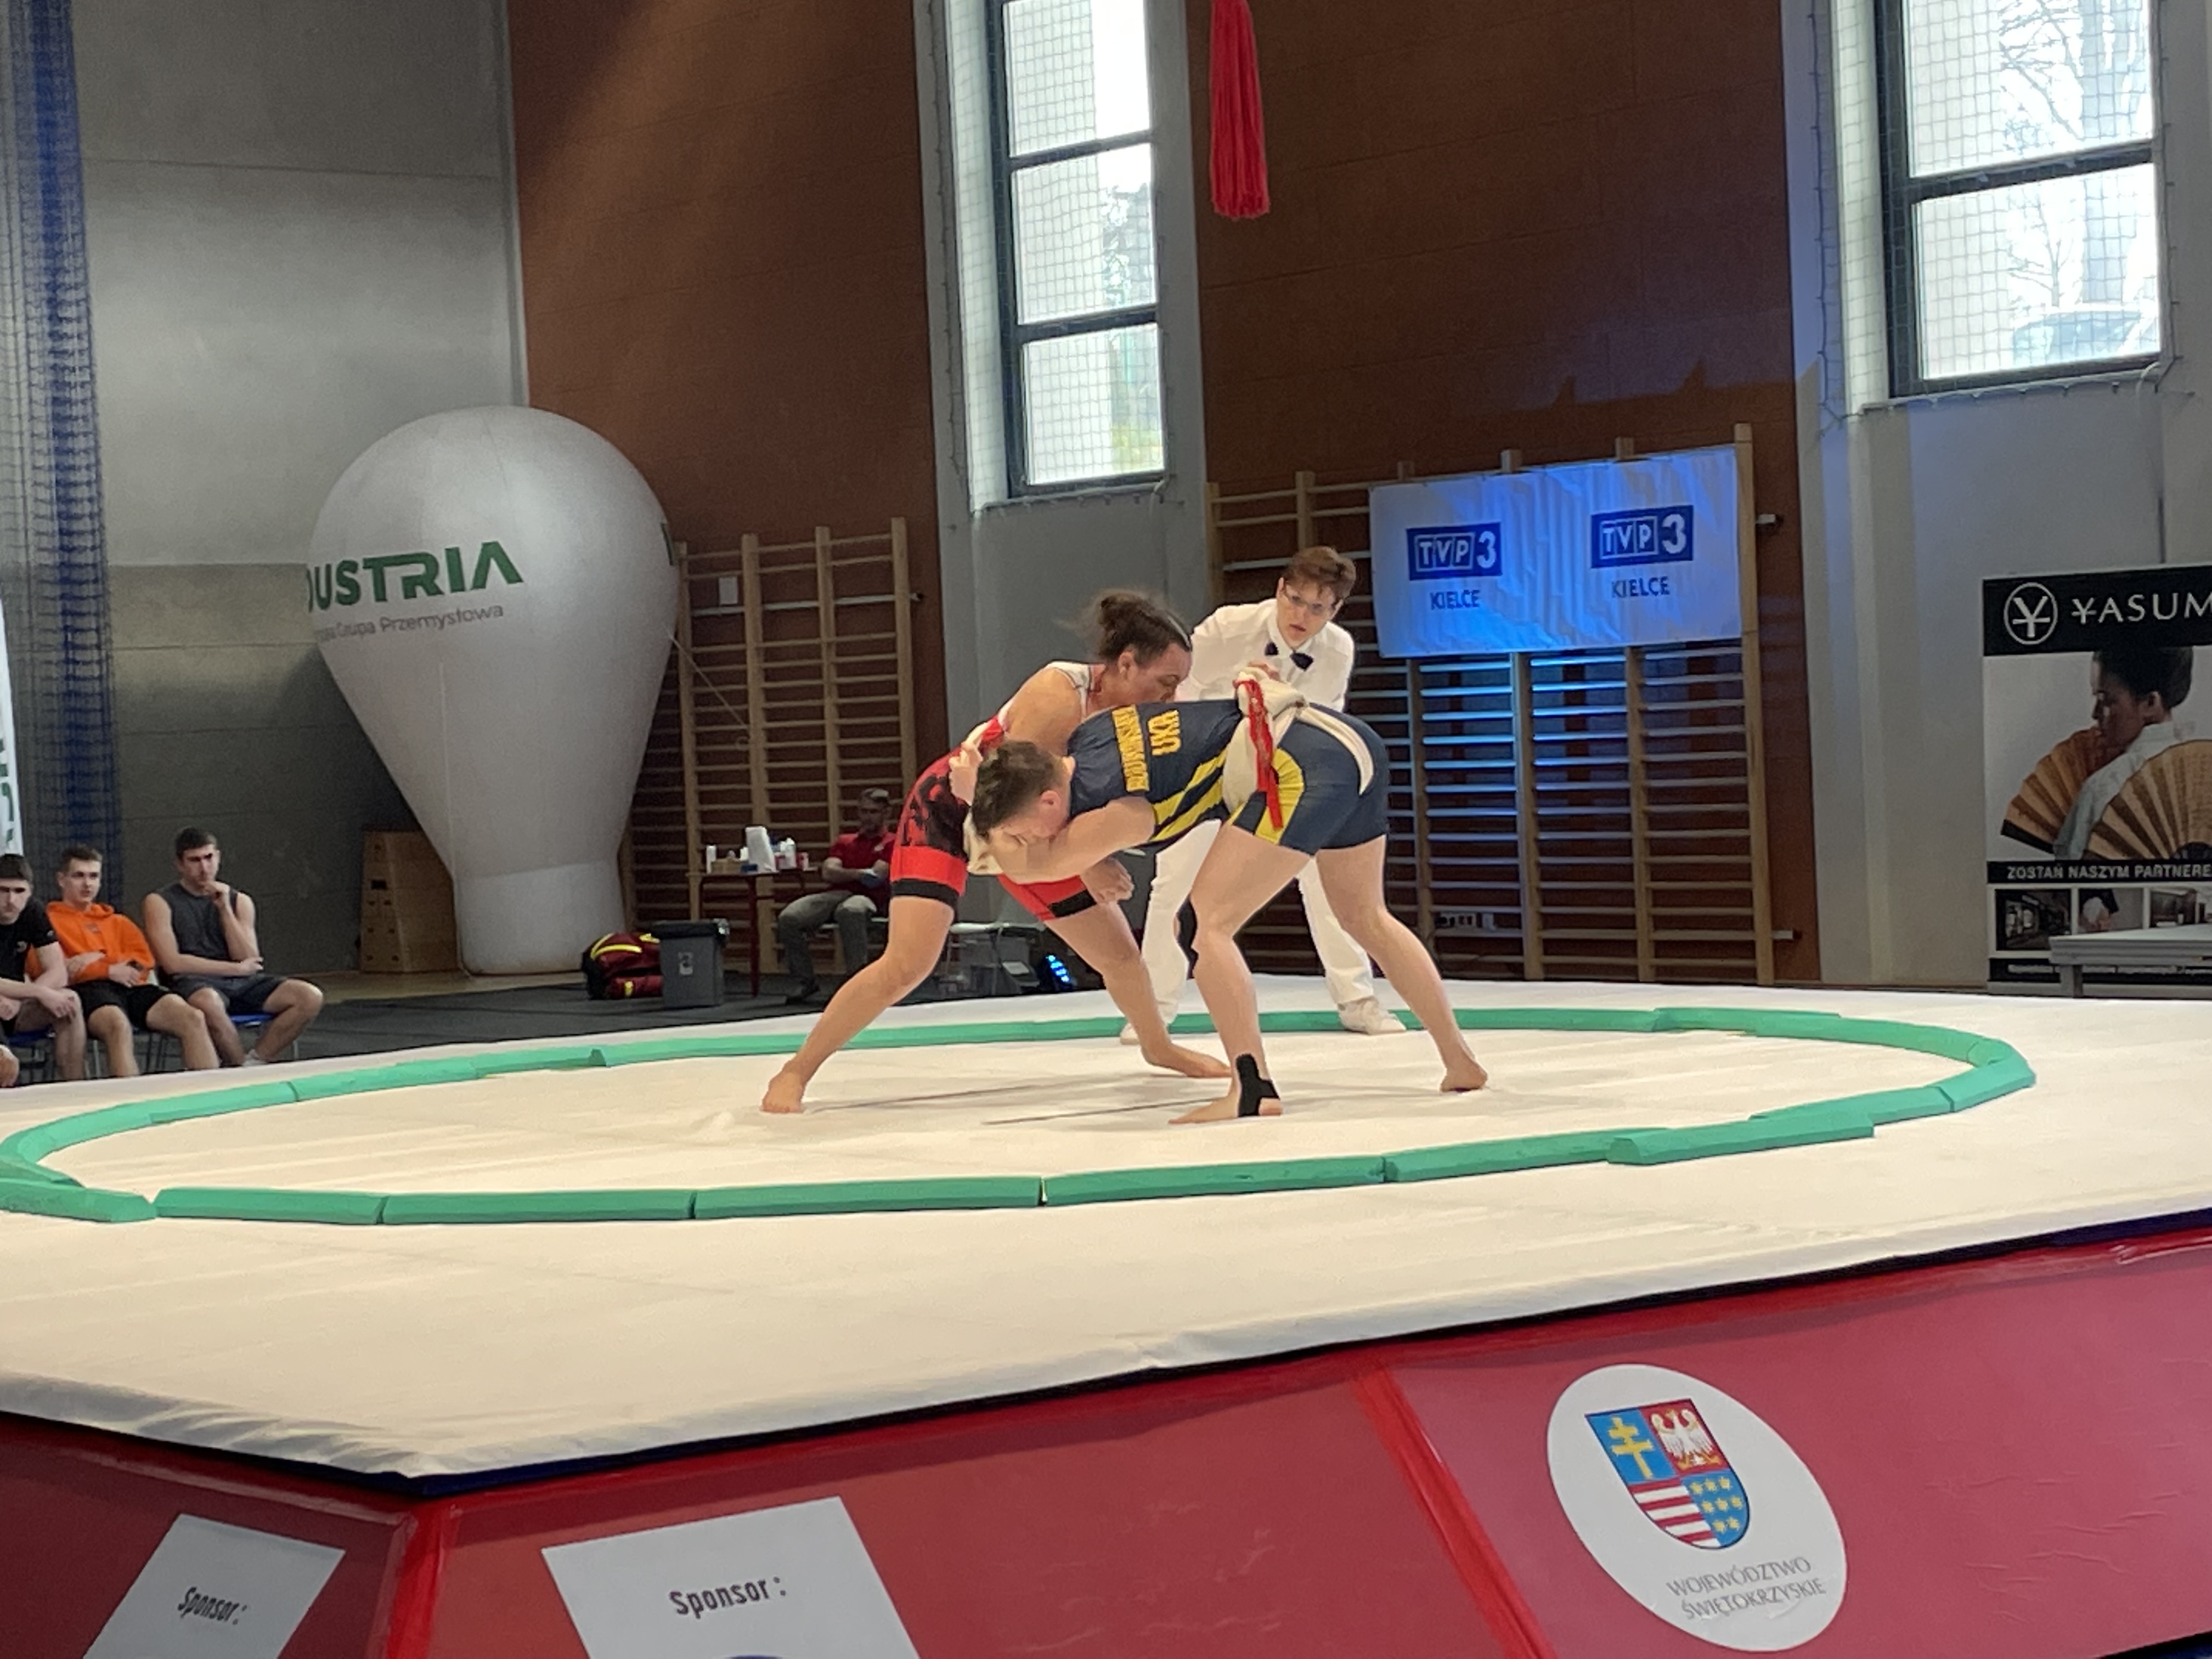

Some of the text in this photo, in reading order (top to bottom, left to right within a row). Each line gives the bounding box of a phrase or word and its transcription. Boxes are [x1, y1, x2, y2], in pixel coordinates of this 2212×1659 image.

[306, 541, 523, 612] USTRIA
[1612, 576, 1670, 599] KIELCE
[1430, 589, 1480, 610] KIELCE
[2007, 863, 2063, 879] ZOSTAŃ
[2068, 865, 2129, 878] NASZYM
[1666, 1556, 1811, 1596] WOJEWÓDZTWO
[1681, 1577, 1826, 1620] ŚWIĘTOKRZYSKIE
